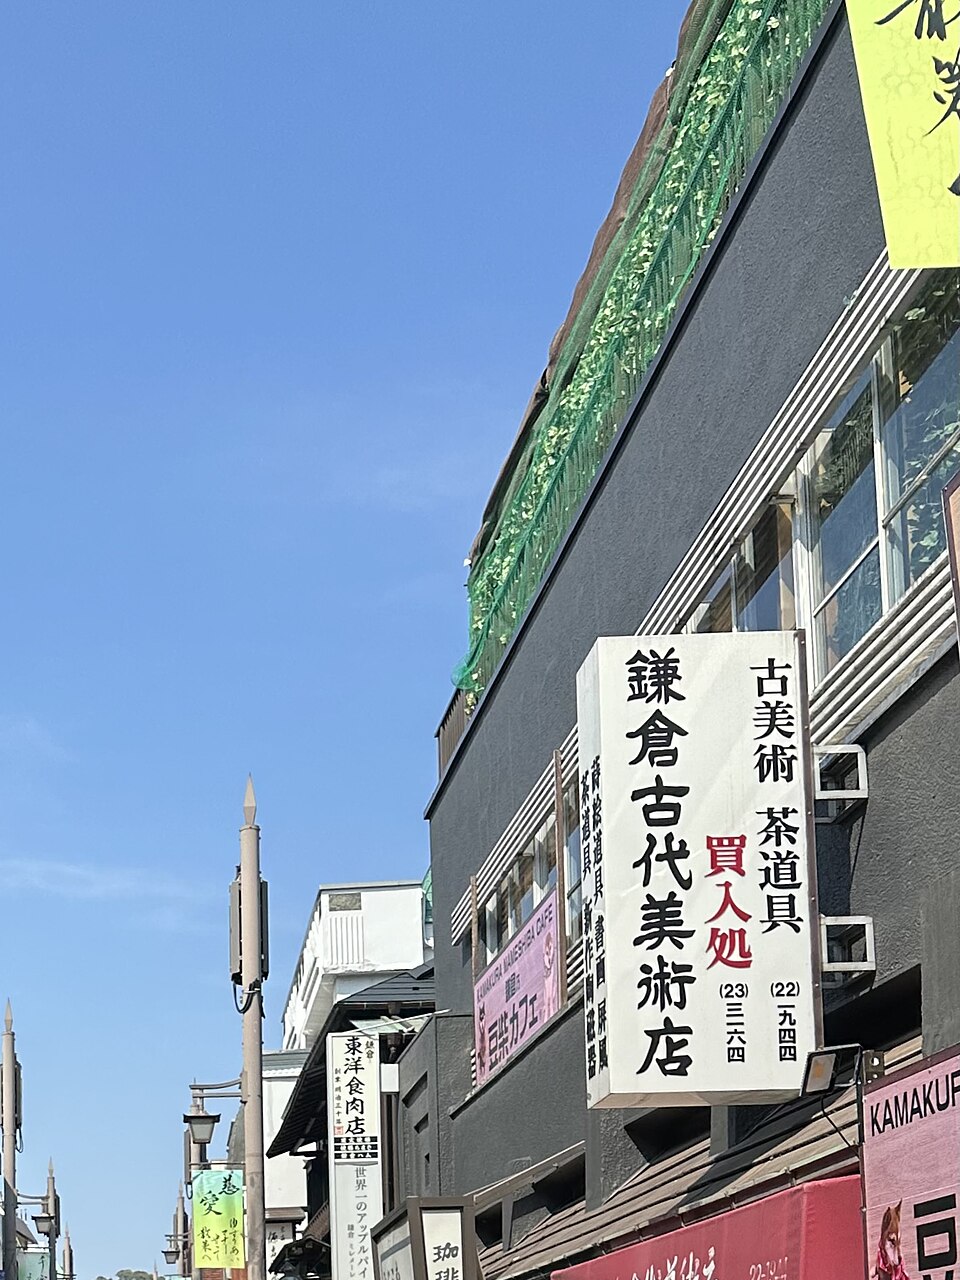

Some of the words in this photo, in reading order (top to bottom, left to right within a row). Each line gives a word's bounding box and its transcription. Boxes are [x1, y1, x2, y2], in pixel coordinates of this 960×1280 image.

[750, 658, 798, 783] 古美術
[626, 646, 696, 1077] 鎌倉古代美術店
[705, 835, 753, 970] 買入処
[756, 807, 803, 934] 茶道具
[536, 903, 553, 938] CAFE
[488, 993, 538, 1072] 豆柴カフェ
[726, 1003, 746, 1064] 三一六四
[777, 1003, 798, 1063] 一九四四
[343, 1036, 365, 1135] 東洋食肉店
[355, 1167, 369, 1279] 世界一のアップルパイ
